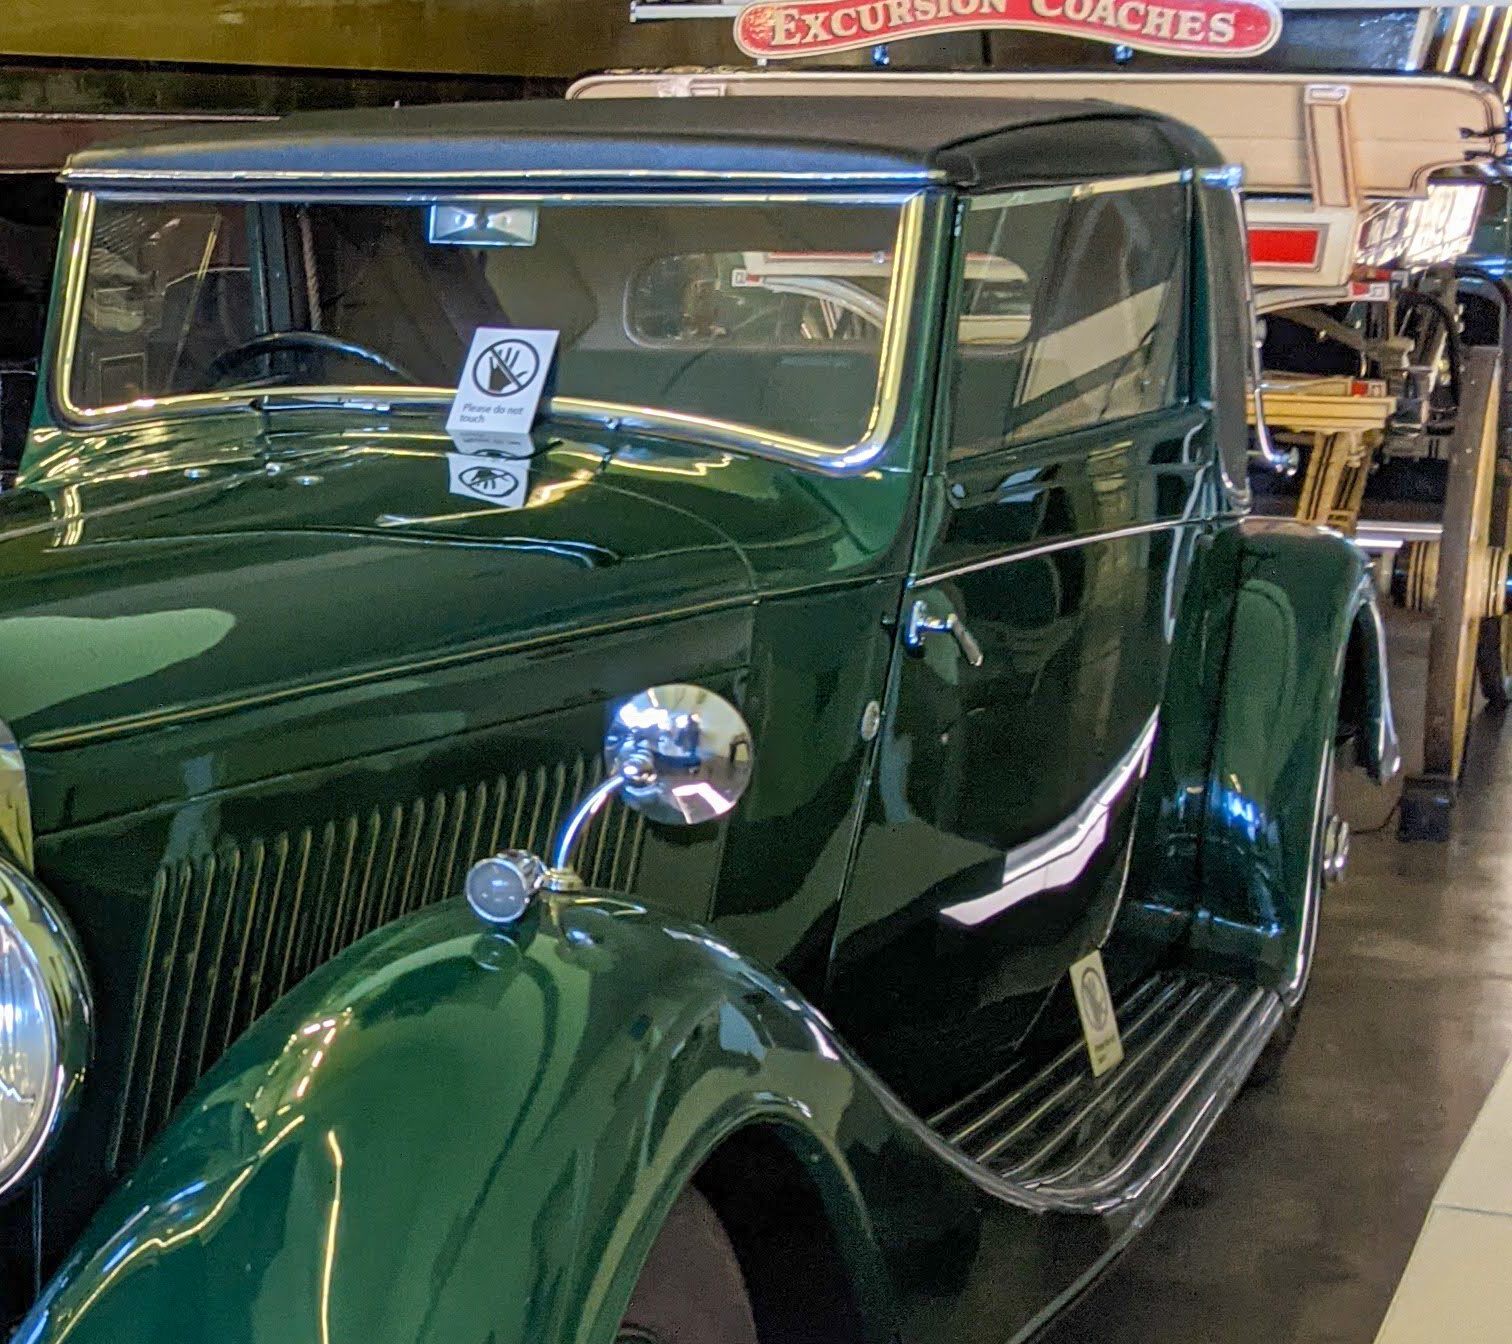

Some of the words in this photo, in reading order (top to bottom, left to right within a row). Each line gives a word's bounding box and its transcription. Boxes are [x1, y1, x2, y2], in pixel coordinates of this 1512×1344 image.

[462, 403, 491, 414] Please
[493, 405, 505, 415] do
[507, 406, 524, 416] not
[459, 414, 485, 424] touch
